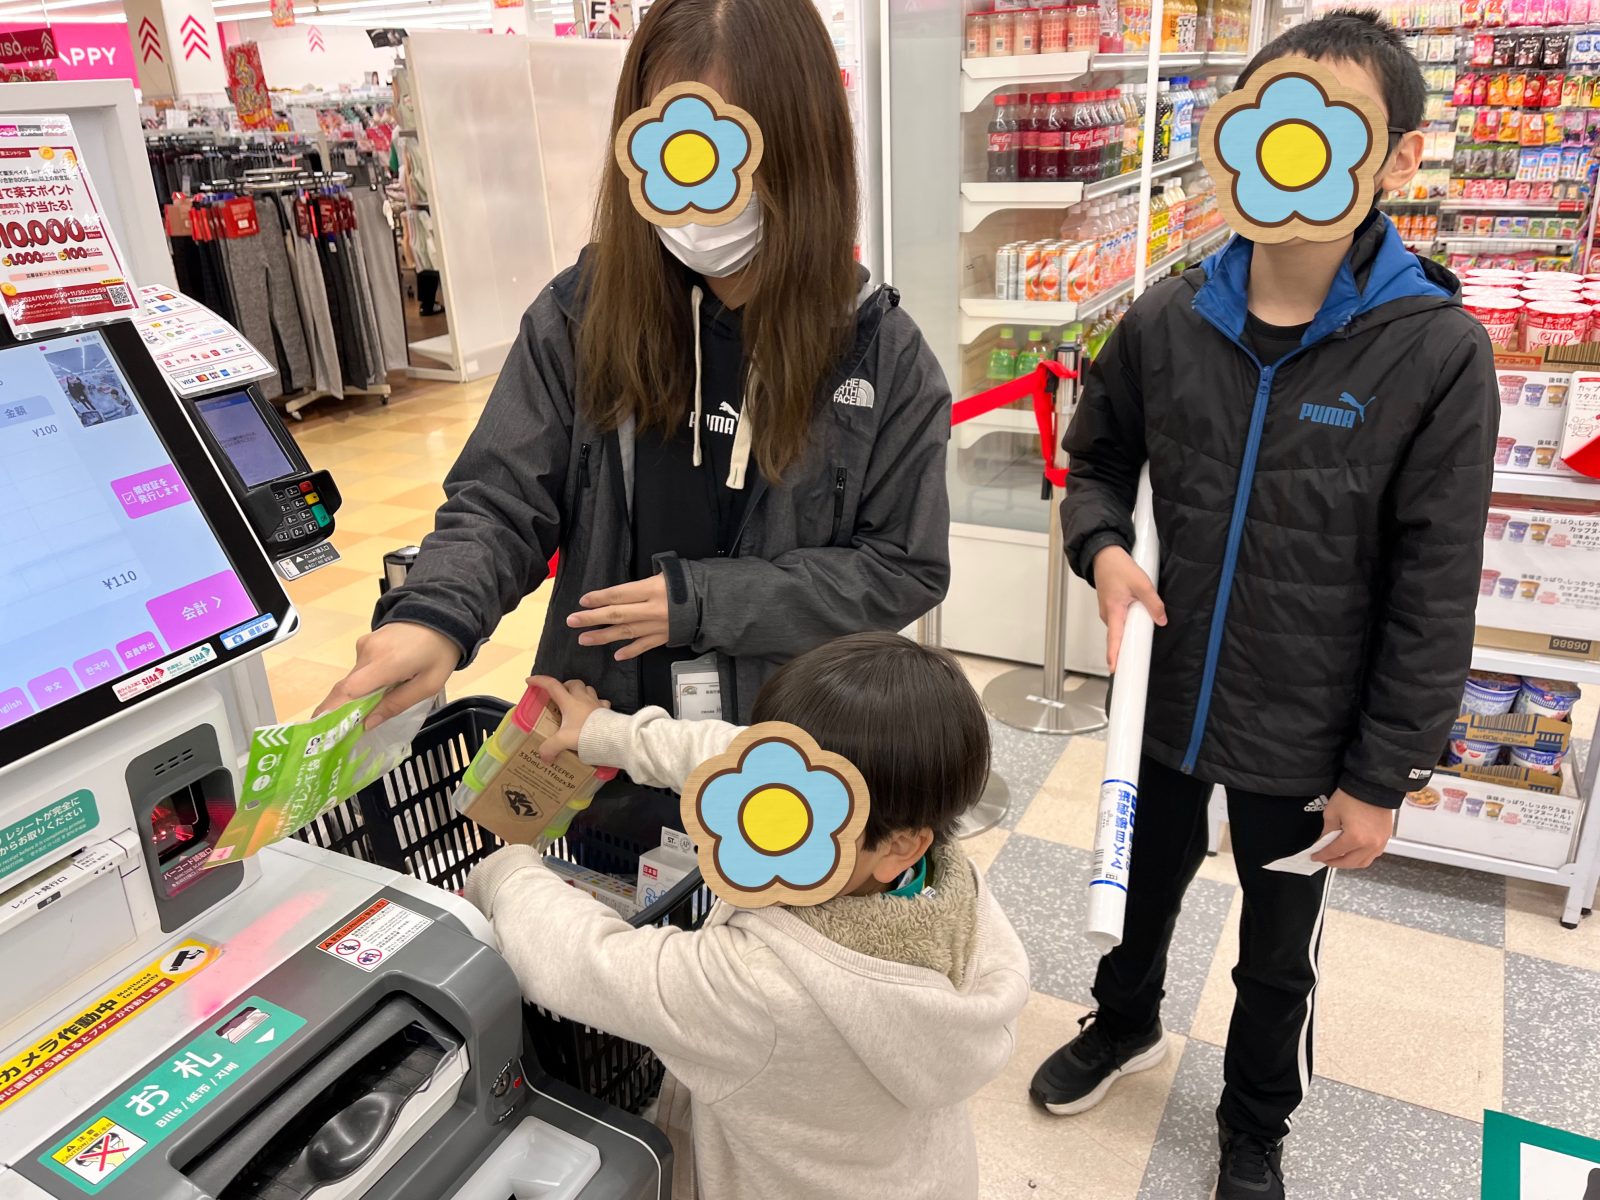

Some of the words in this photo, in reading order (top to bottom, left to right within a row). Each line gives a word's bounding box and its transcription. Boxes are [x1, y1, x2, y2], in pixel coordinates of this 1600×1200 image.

[0, 41, 21, 57] ISO
[845, 378, 860, 388] HE
[833, 395, 857, 405] FACE
[4, 405, 27, 420] 金額
[689, 411, 735, 435] PMA
[1299, 402, 1356, 428] PUMA
[137, 484, 181, 505] 発行します
[102, 570, 138, 591] ¥110
[181, 600, 209, 621] 会計
[188, 651, 205, 665] SIAA
[142, 672, 160, 687] SIAA
[551, 763, 576, 781] KEEPER
[11, 876, 68, 909] レシート発行口
[117, 973, 152, 998] Monitored
[0, 998, 118, 1082] カメラ作動中
[155, 1107, 183, 1128] Bills
